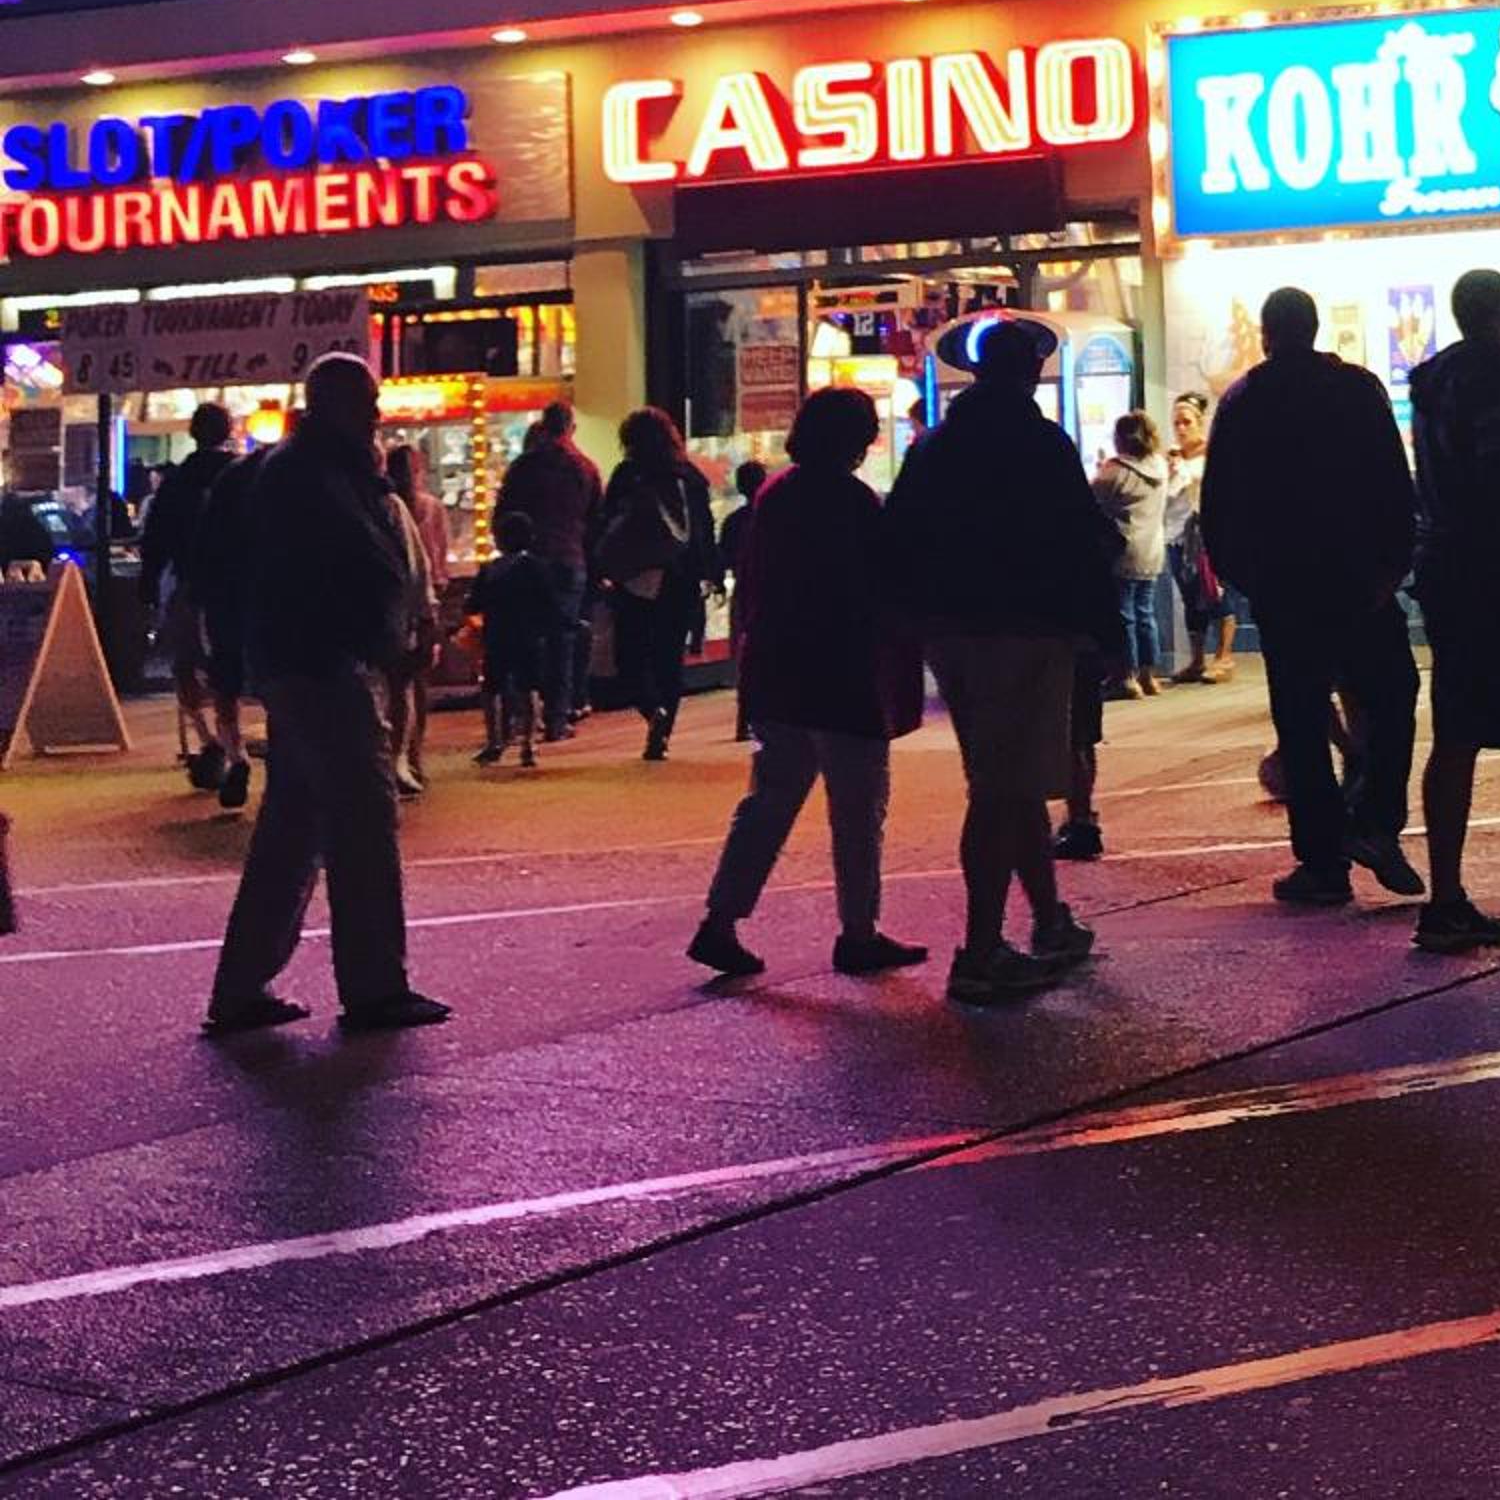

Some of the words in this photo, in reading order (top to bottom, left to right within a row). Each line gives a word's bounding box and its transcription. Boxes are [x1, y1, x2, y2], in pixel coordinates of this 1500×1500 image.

[2, 85, 469, 192] SLOT/POKER
[602, 37, 1136, 183] CASINO
[1195, 53, 1478, 194] KOHR
